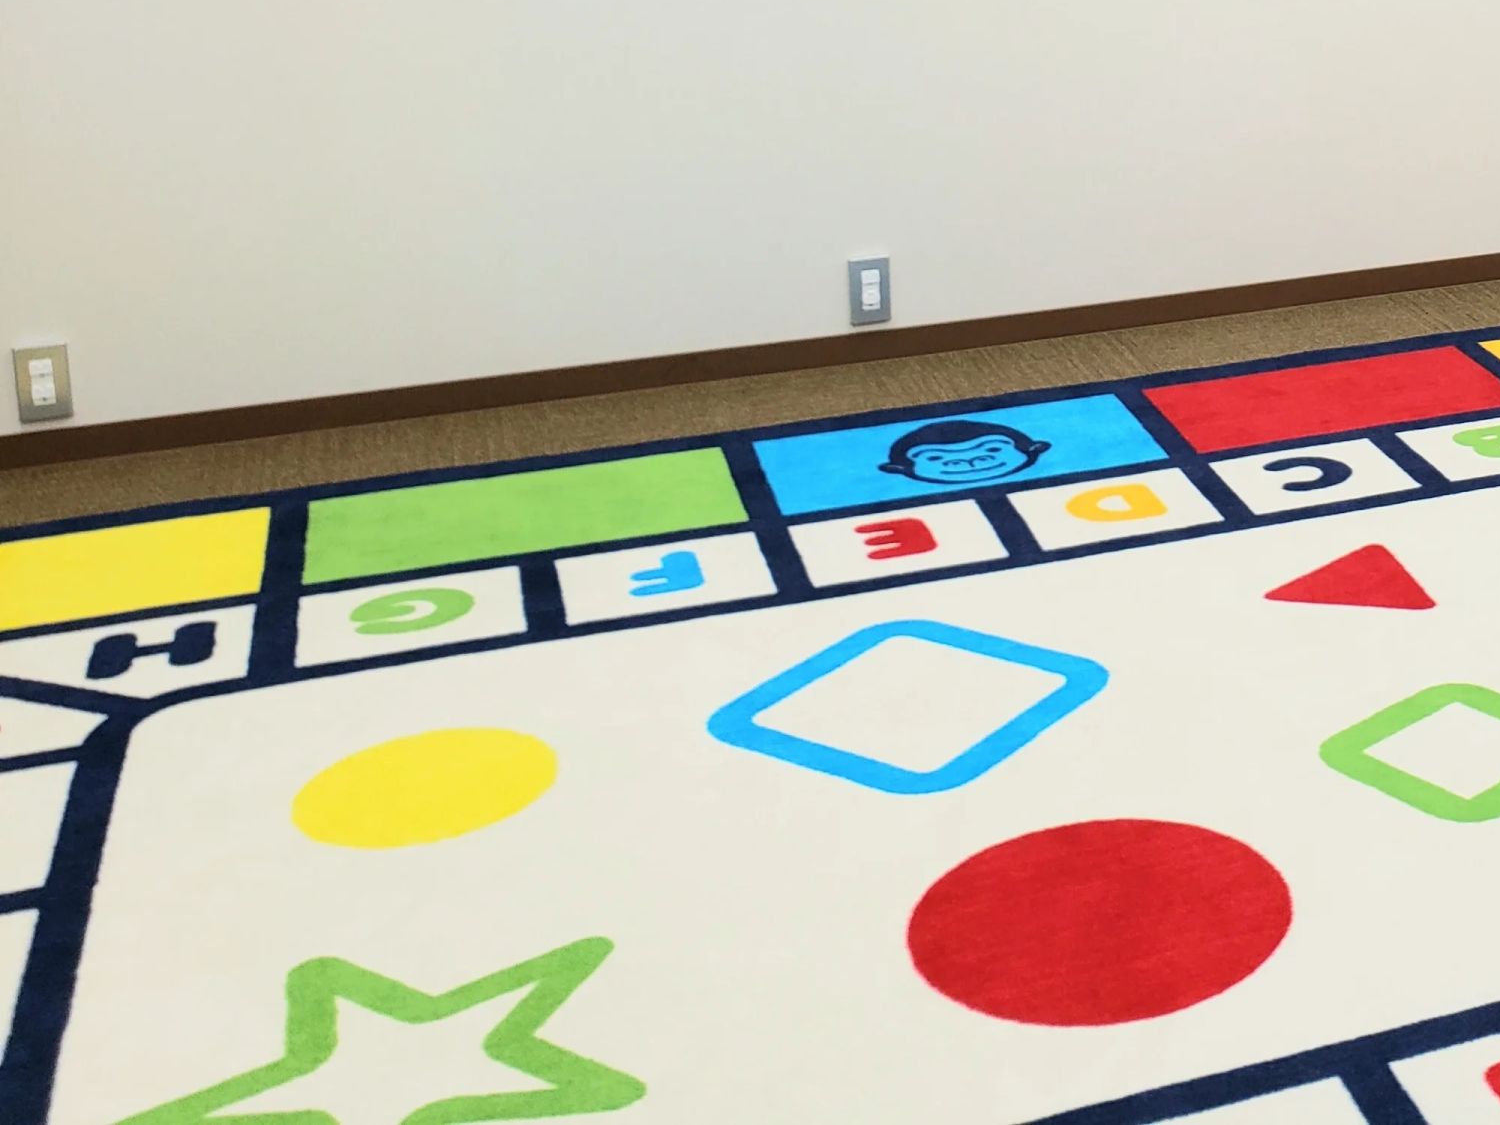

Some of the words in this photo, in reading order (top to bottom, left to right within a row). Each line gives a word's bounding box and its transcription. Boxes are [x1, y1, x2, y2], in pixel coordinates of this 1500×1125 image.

[1262, 456, 1353, 492] C
[1065, 483, 1168, 522] D
[855, 517, 938, 560] E
[629, 550, 705, 597] F
[350, 587, 475, 634] G
[85, 620, 218, 679] H
